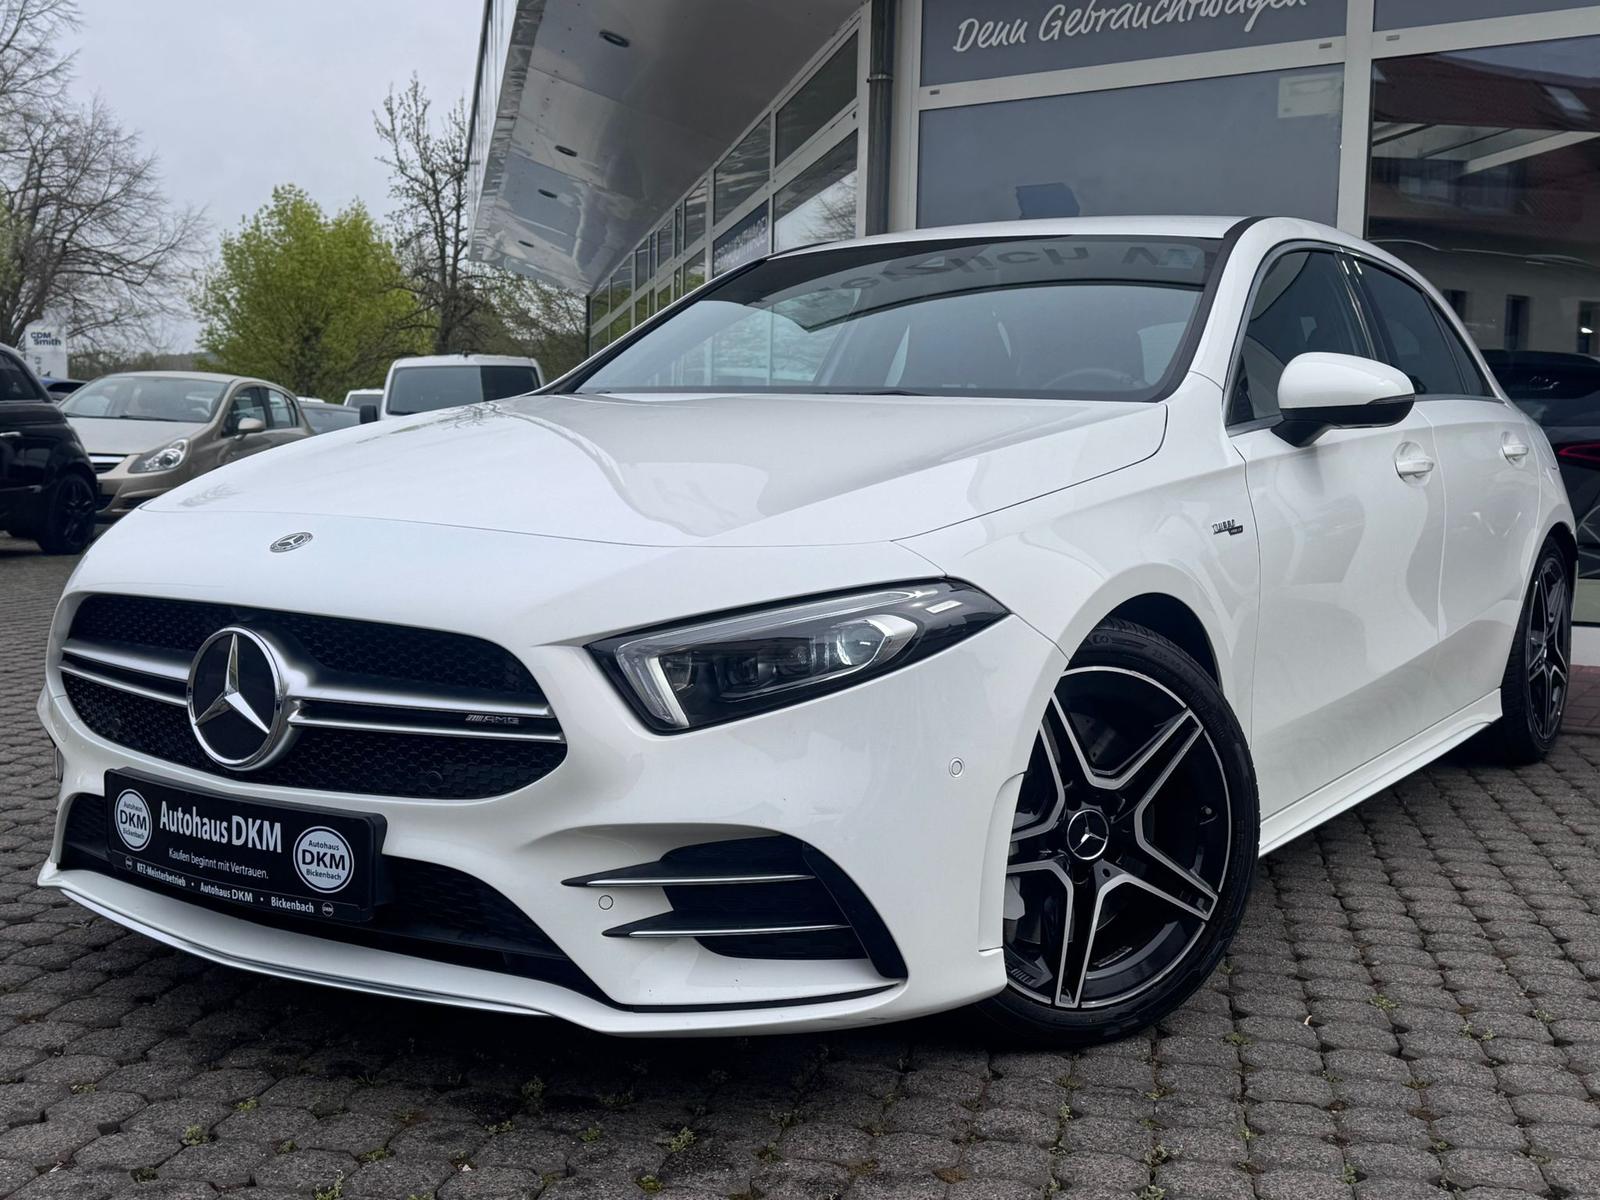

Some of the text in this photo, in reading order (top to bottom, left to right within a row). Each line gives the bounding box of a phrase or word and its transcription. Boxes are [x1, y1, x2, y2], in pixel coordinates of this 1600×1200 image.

[953, 0, 1308, 52] Denn Gebrauchtwag
[33, 337, 62, 346] Smith
[481, 715, 519, 725] AMG
[120, 809, 147, 831] DKM
[160, 800, 282, 853] Autohaus DKM
[308, 839, 340, 851] Autohaus
[168, 847, 269, 879] Kaufen beginnt mit Vertrauen.
[301, 848, 346, 871] DKM
[305, 868, 342, 881] Bickenbach
[200, 881, 231, 898] Autohaus
[231, 889, 253, 903] DKM
[270, 896, 315, 913] Bickenbach
